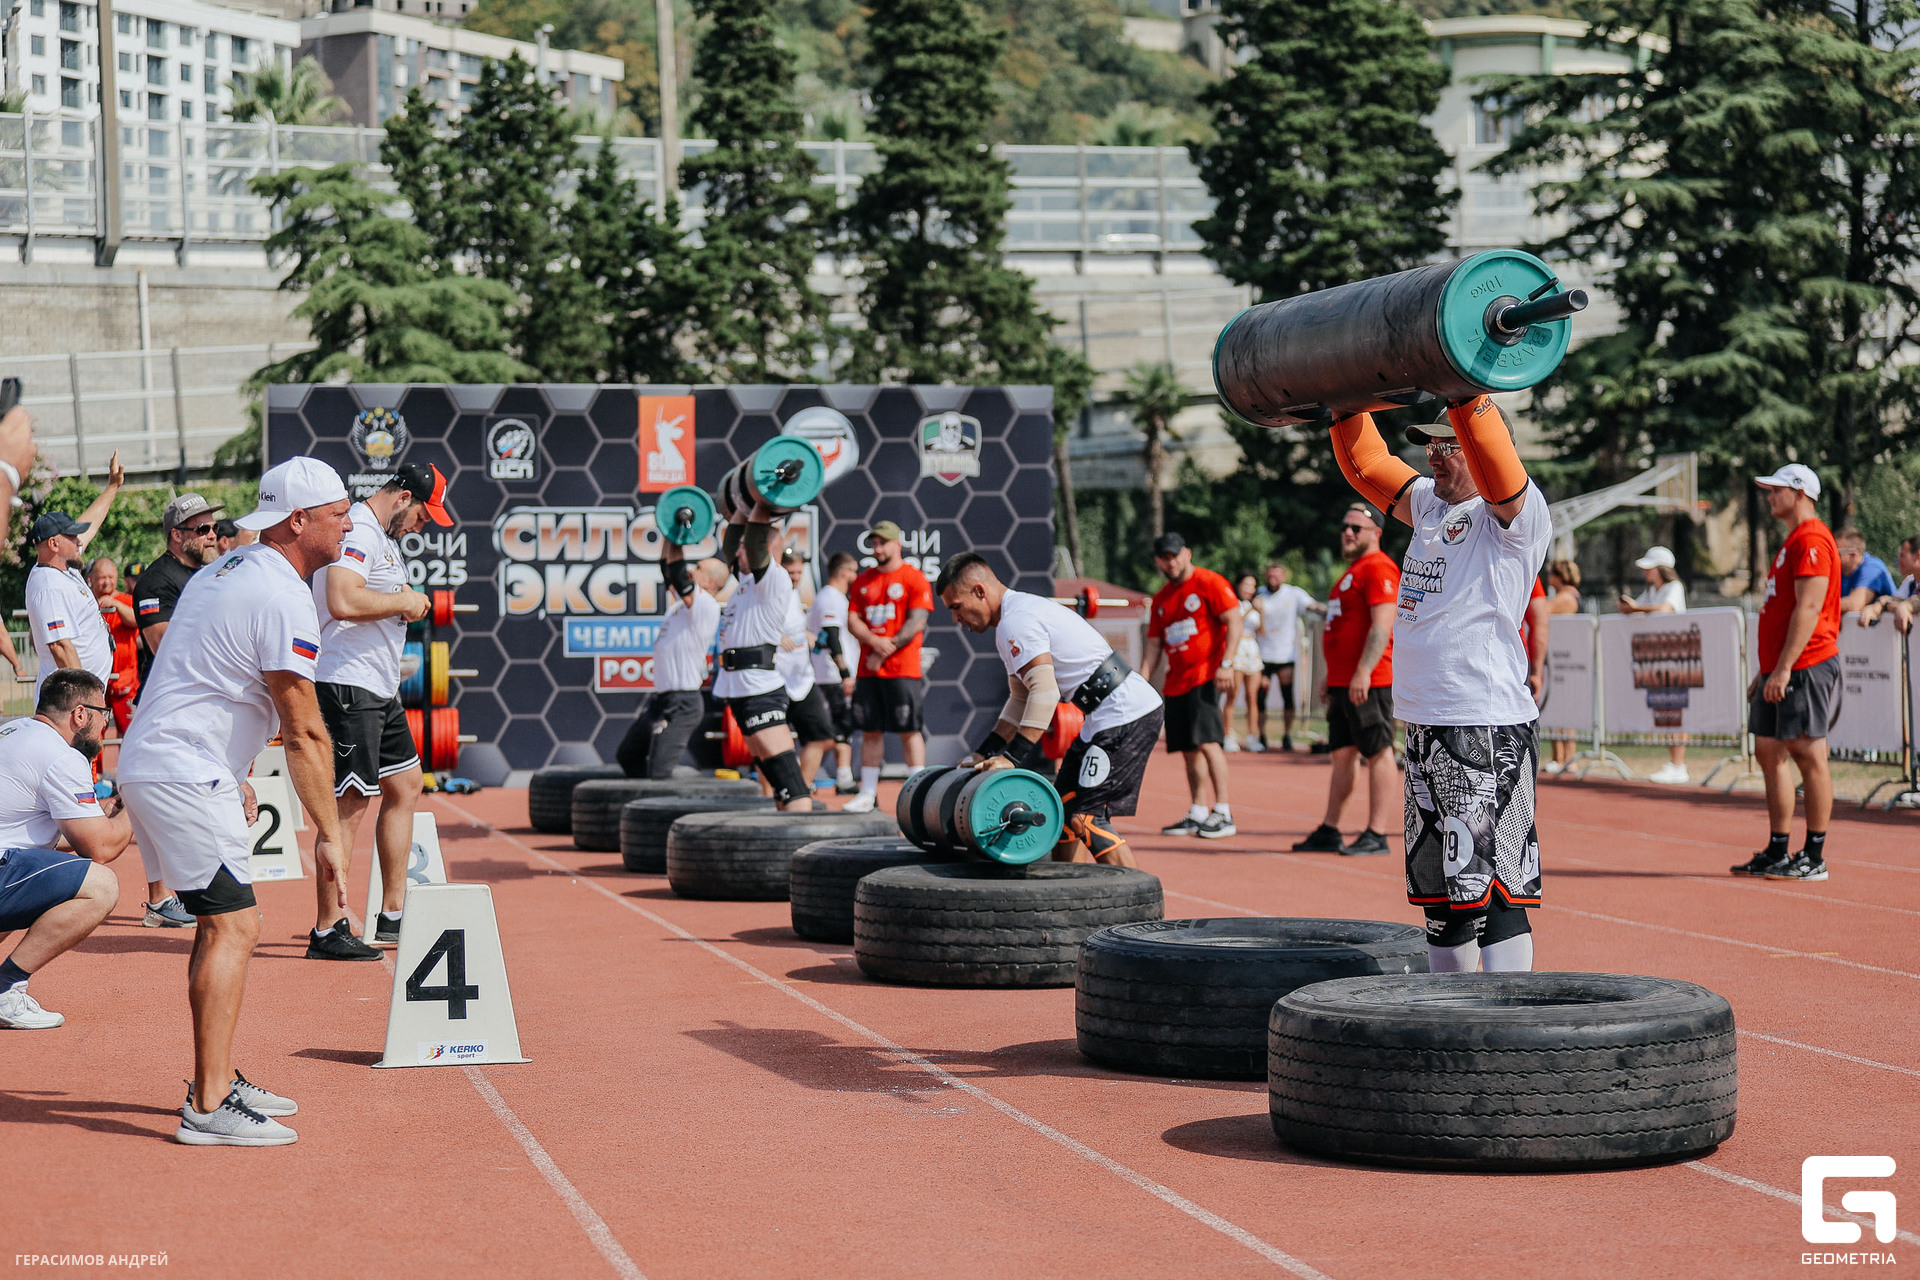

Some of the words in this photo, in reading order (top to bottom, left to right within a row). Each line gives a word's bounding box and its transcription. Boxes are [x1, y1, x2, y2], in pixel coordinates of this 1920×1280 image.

[261, 491, 276, 502] Klein
[400, 532, 467, 558] ОЧИ
[856, 529, 941, 555] СЧИ
[408, 559, 469, 586] 025
[252, 803, 283, 856] 2
[405, 928, 479, 1020] 4
[449, 1044, 484, 1054] KERKO
[457, 1052, 475, 1060] sport
